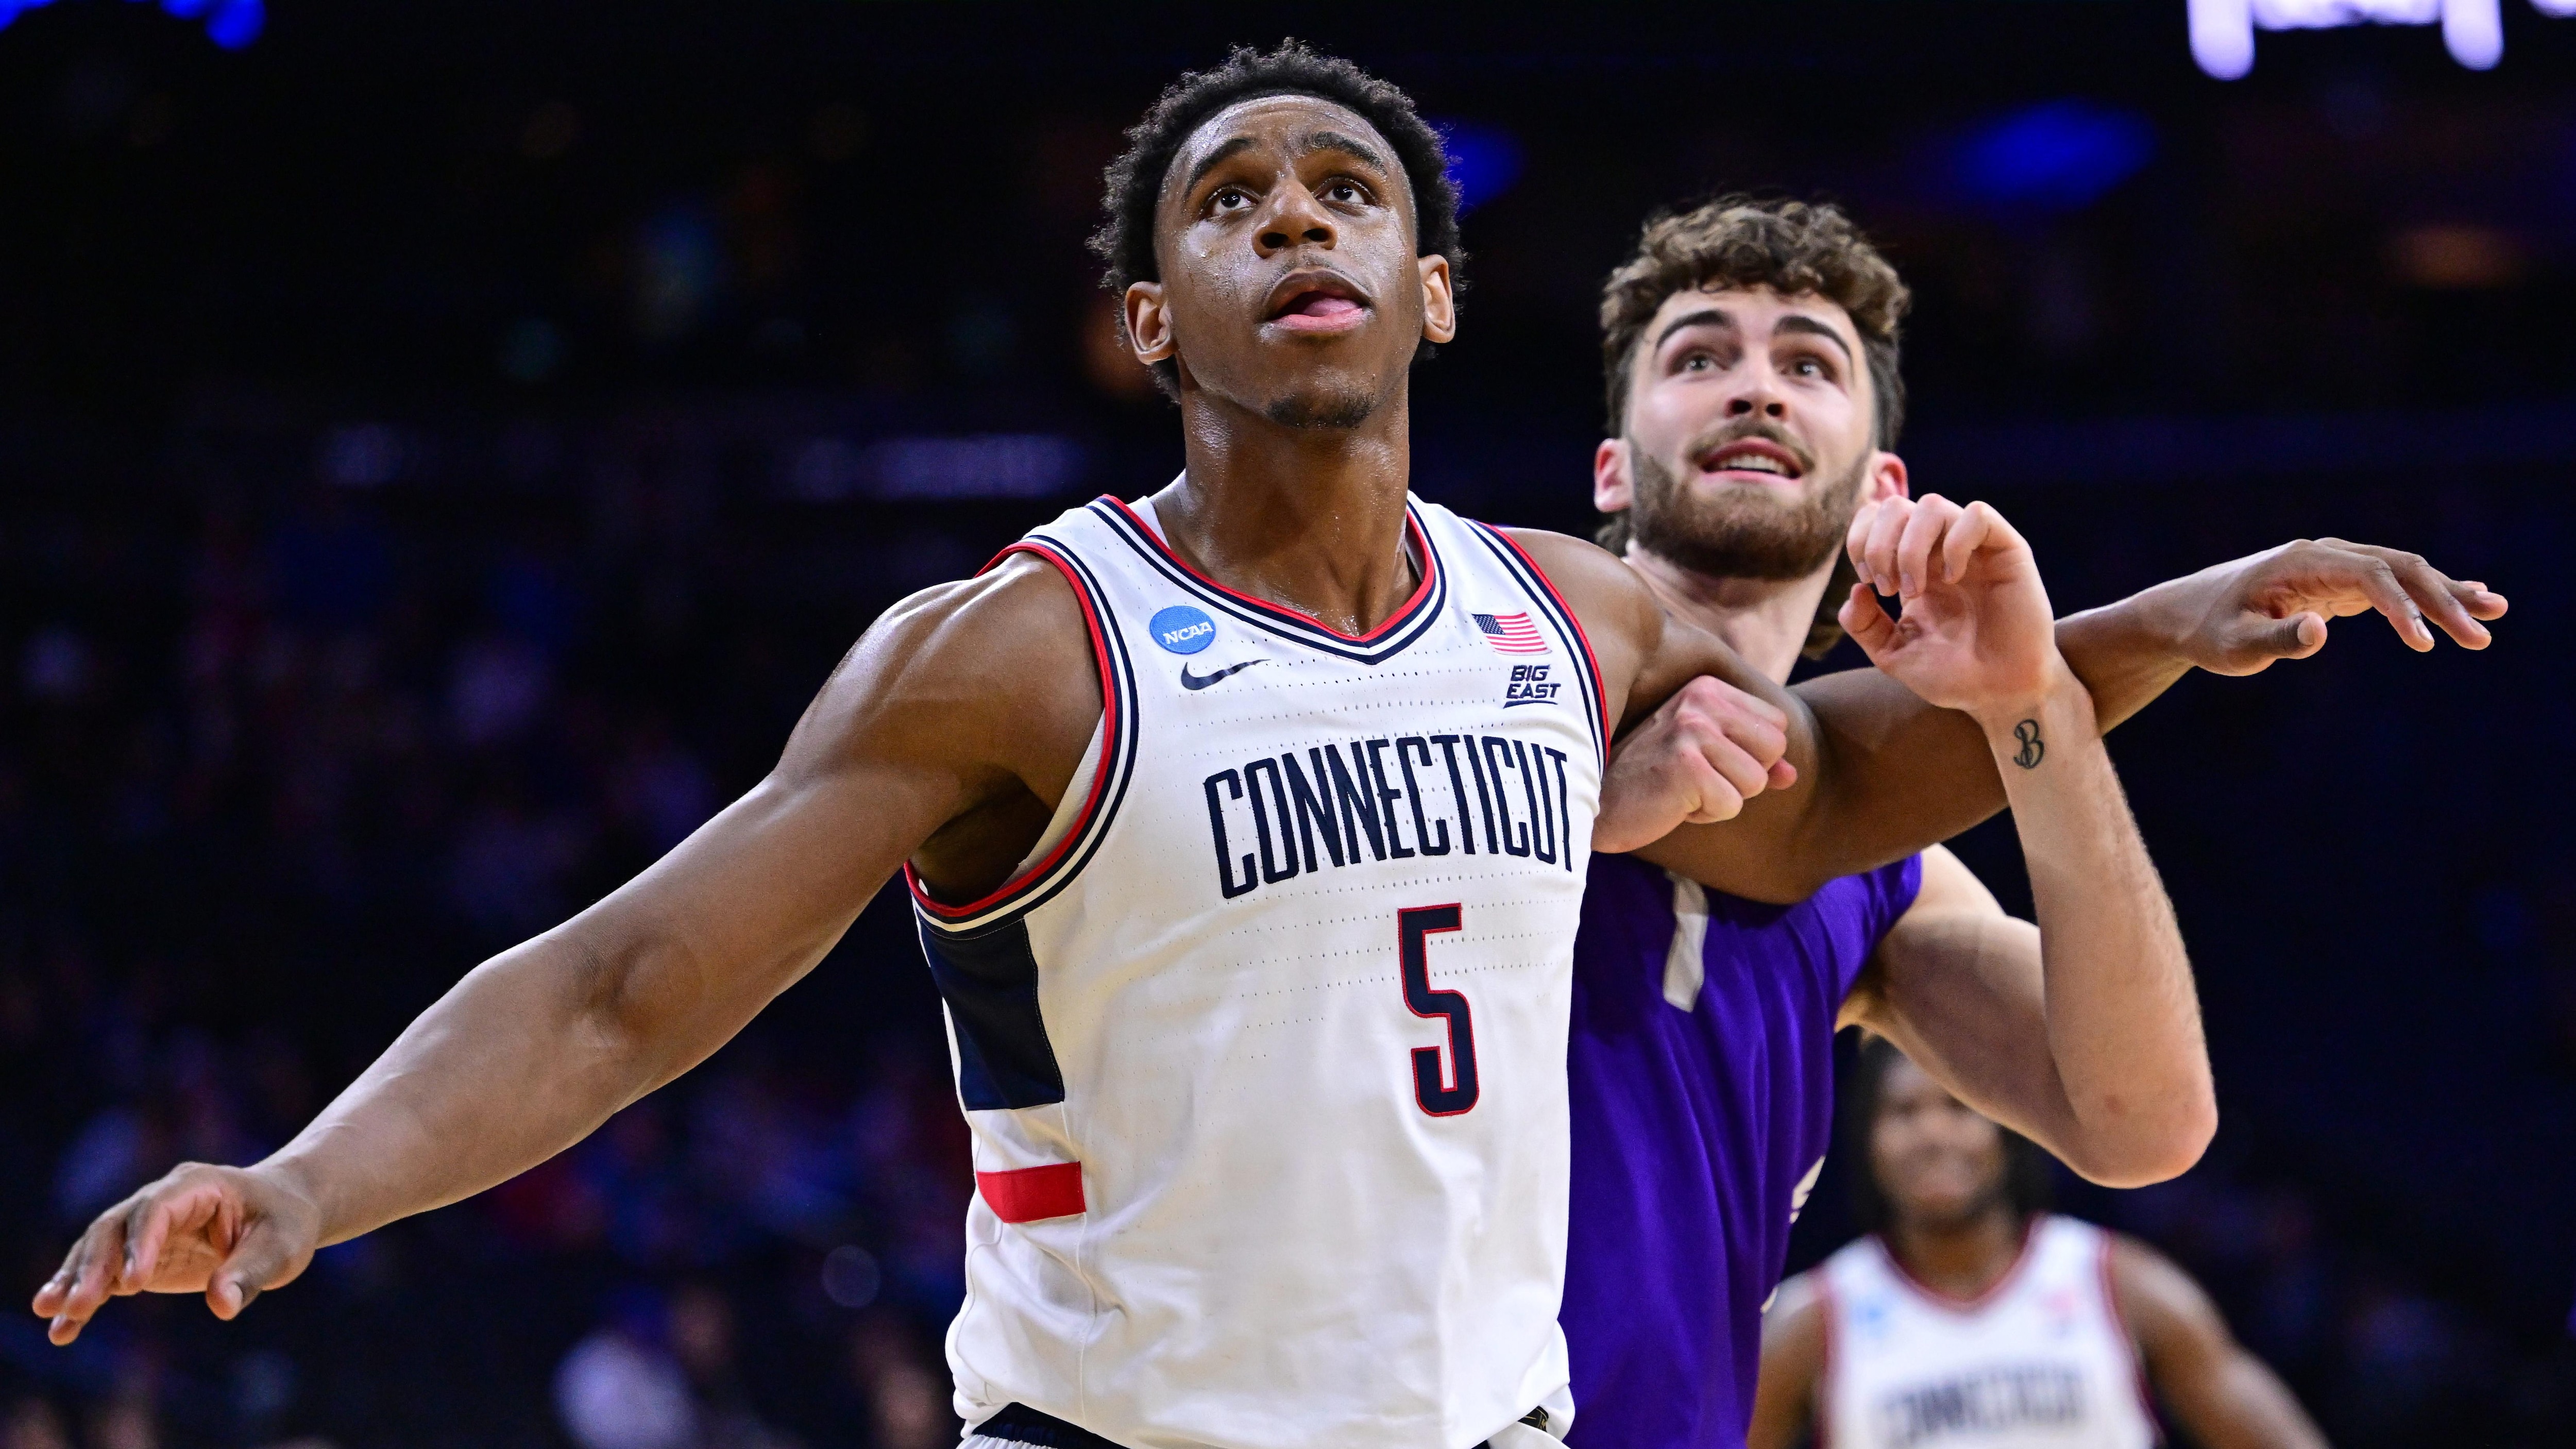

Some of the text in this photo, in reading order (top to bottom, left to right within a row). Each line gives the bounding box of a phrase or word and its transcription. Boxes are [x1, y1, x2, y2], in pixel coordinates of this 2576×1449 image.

[1163, 622, 1214, 644] NCAA
[1506, 683, 1561, 699] EAST
[1511, 664, 1551, 682] BIG
[2013, 718, 2045, 769] B
[1204, 735, 1572, 899] CONNECTICUT
[1397, 902, 1479, 1117] 5
